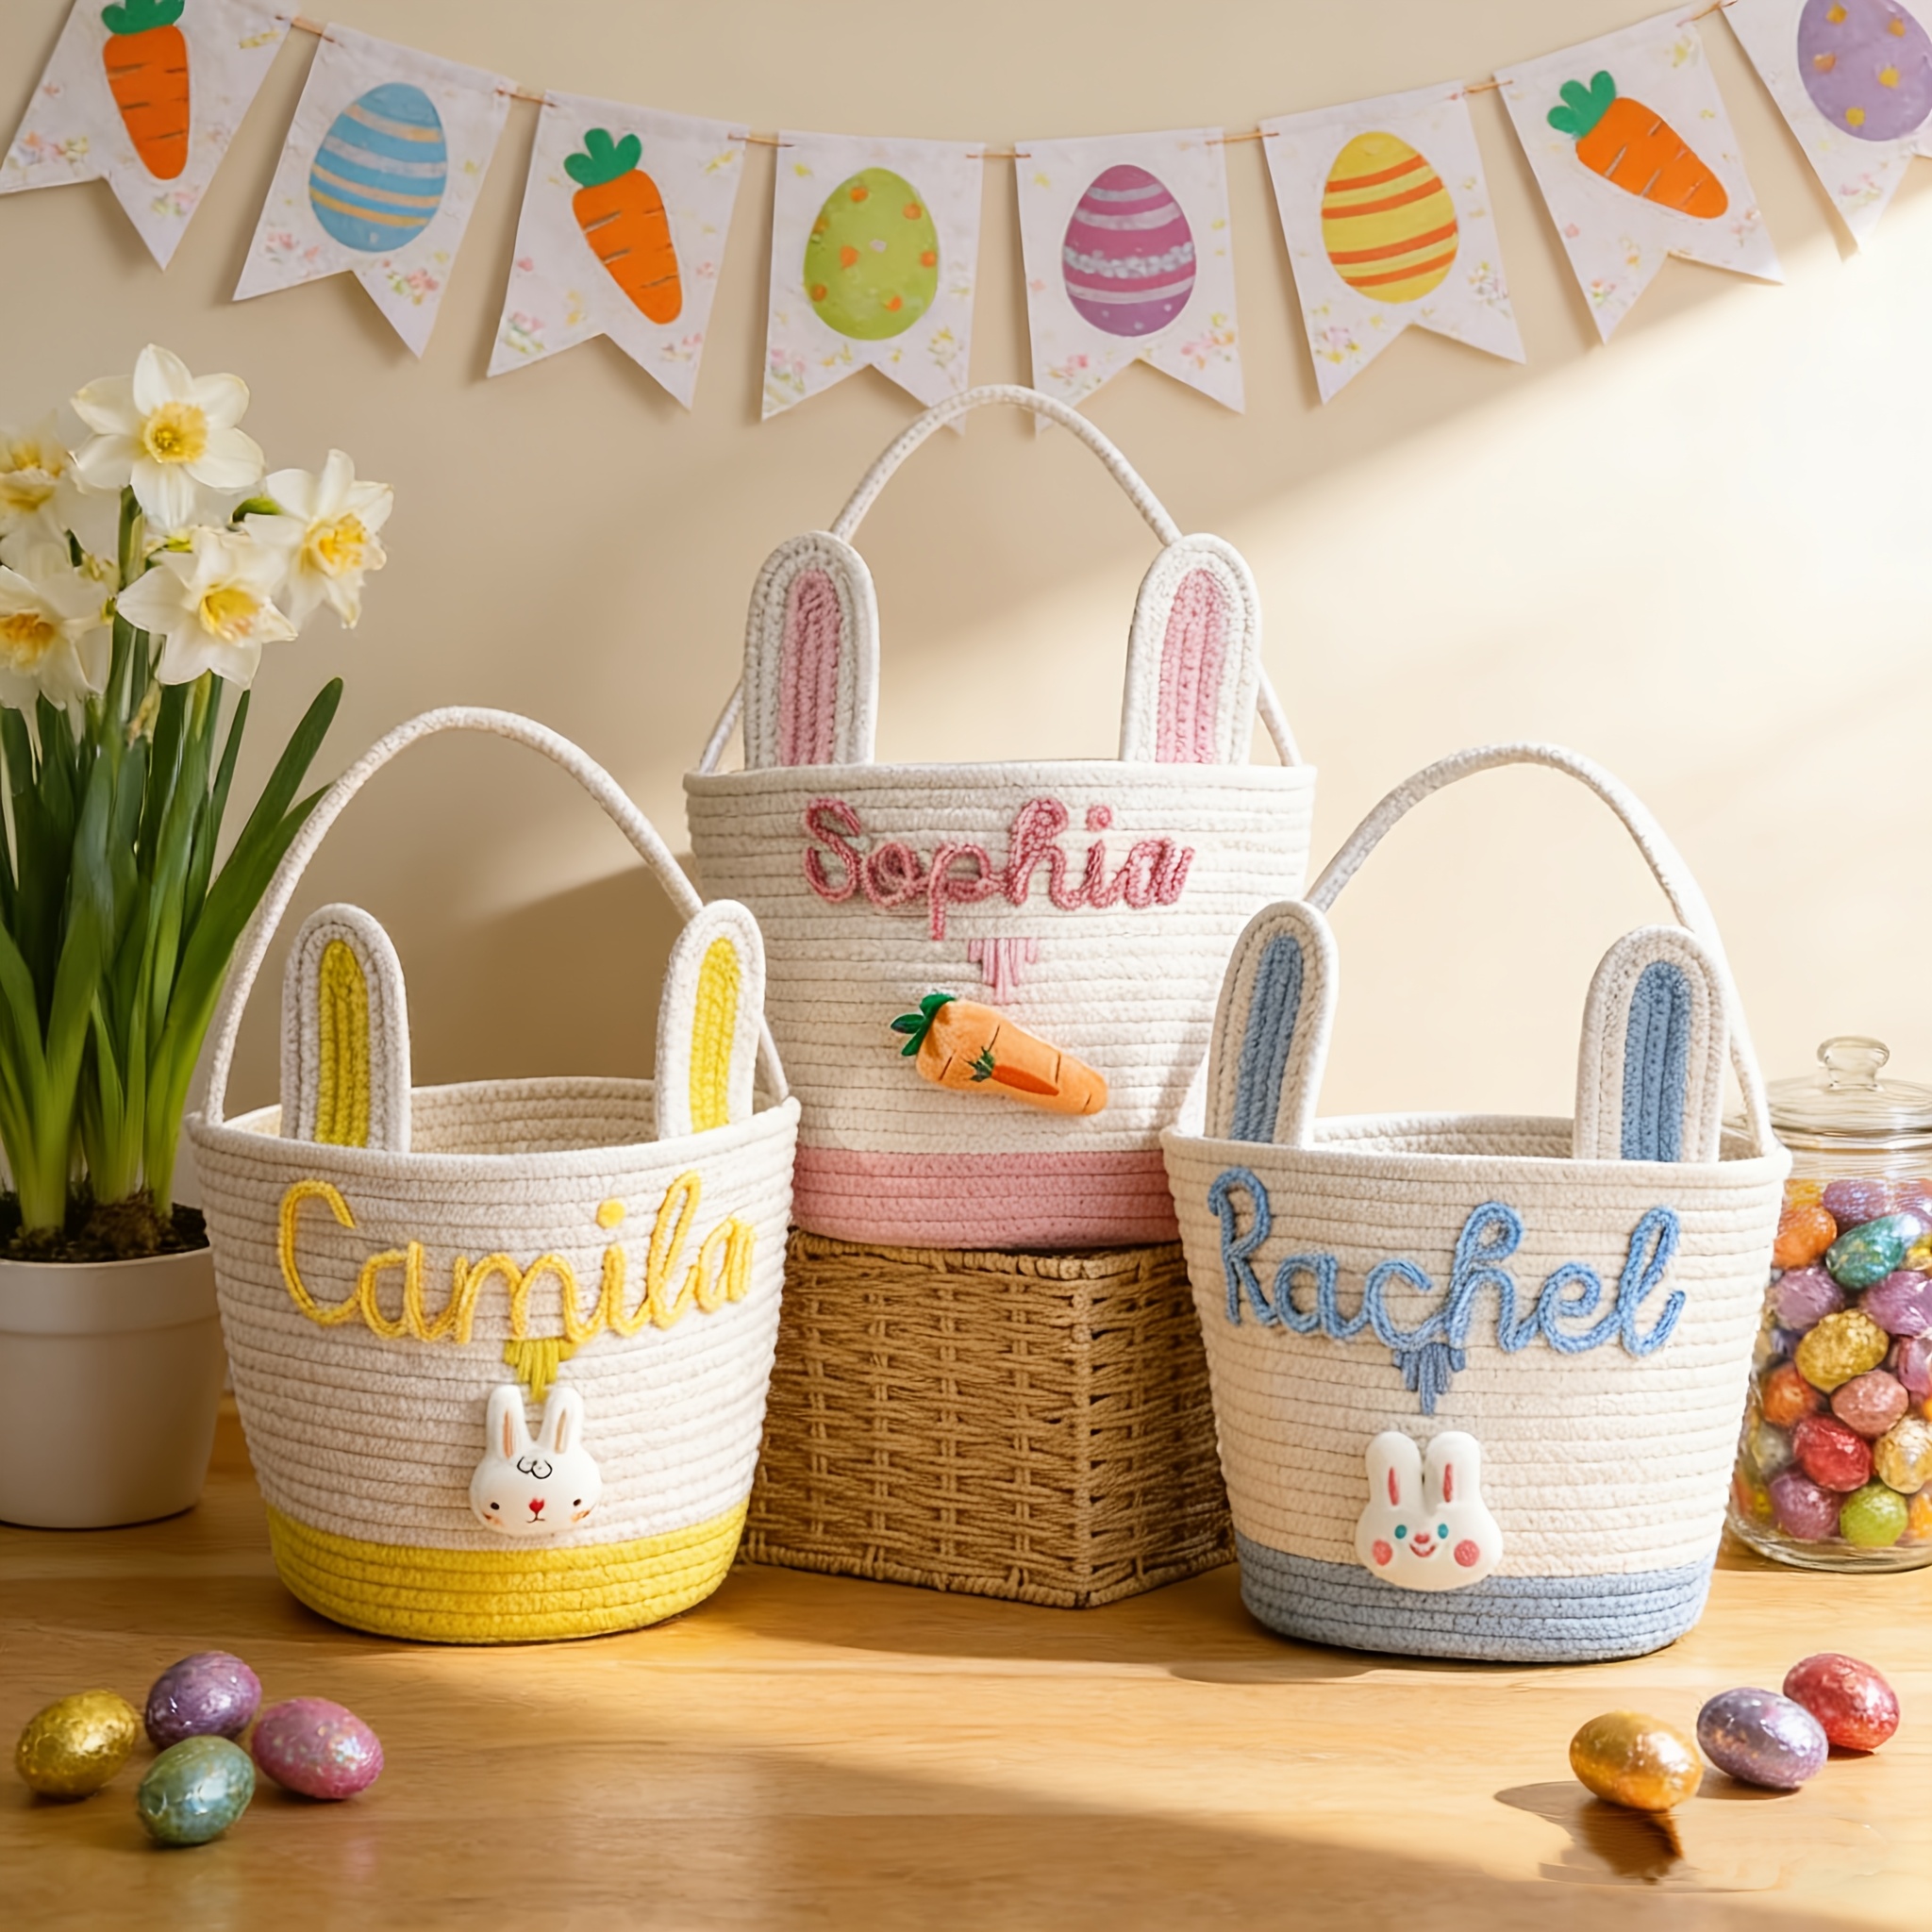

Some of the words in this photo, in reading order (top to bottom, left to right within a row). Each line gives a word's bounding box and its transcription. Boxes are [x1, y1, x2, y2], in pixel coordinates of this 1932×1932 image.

[805, 797, 1194, 941] Sophia
[278, 1170, 755, 1343] Camila
[1208, 1167, 1686, 1357] Rachel
